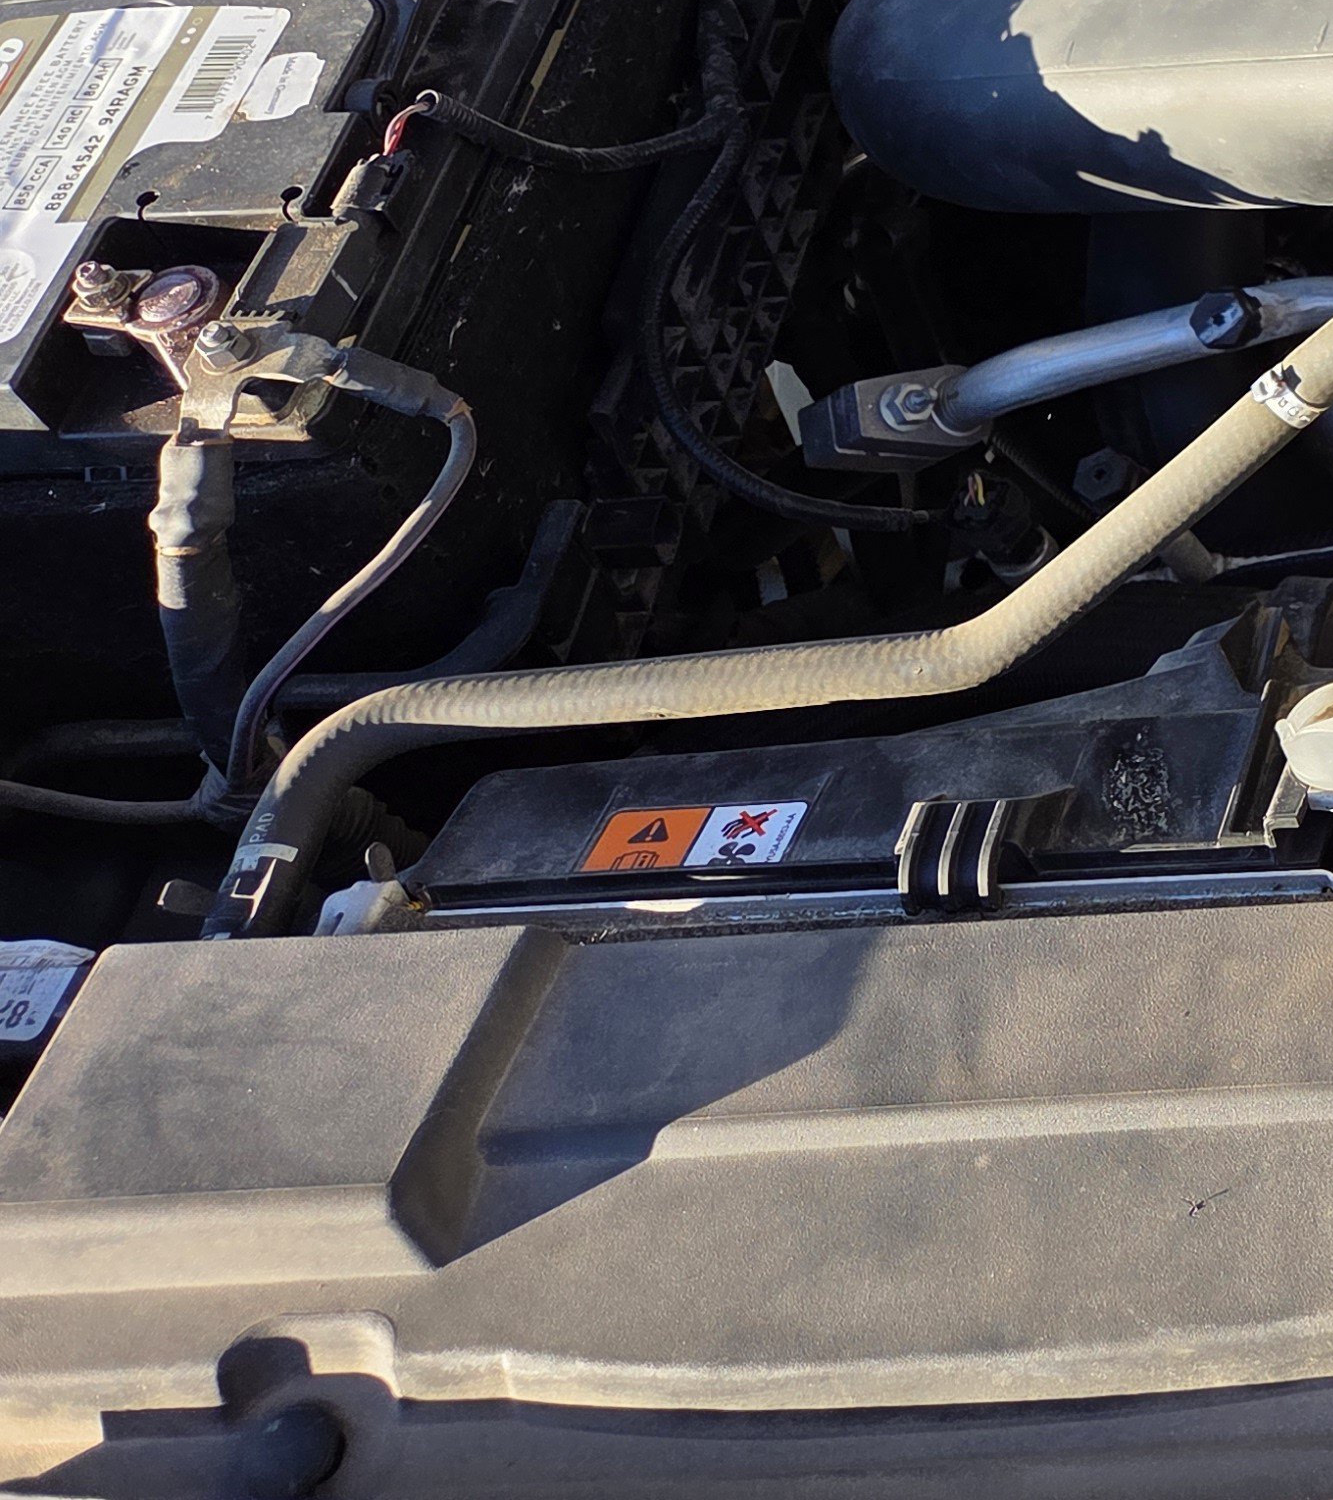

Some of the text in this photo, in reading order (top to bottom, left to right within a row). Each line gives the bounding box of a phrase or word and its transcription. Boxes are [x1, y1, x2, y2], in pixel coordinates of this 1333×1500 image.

[31, 71, 54, 98] FREE
[50, 20, 87, 67] BATTERY
[83, 84, 100, 97] 80
[44, 135, 105, 211] 88864542
[99, 65, 148, 125] 94RAGM
[52, 109, 83, 146] 140 RC
[14, 160, 53, 205] 850 CCA
